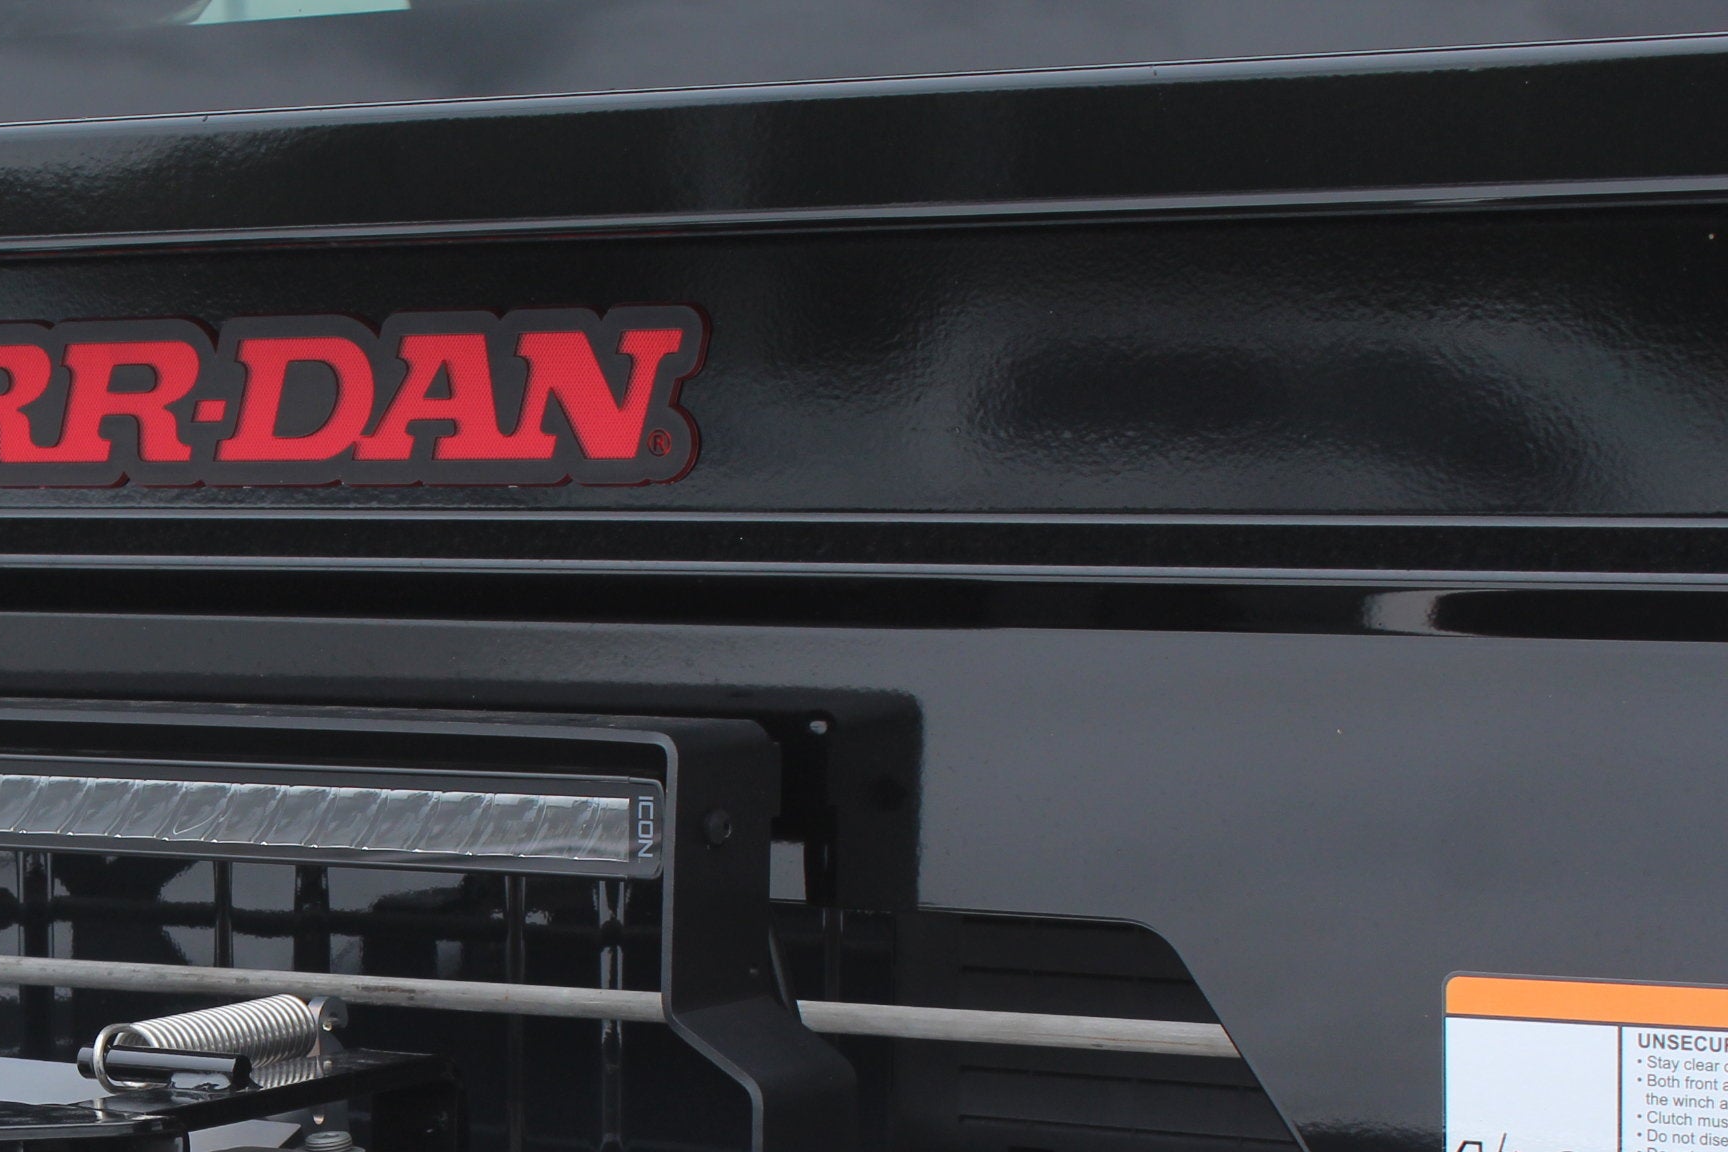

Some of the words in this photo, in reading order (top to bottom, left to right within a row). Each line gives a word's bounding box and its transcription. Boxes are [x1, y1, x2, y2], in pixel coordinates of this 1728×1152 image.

[638, 796, 654, 858] ICON
[1647, 1055, 1680, 1073] Stay
[1684, 1058, 1720, 1072] clear
[1647, 1074, 1680, 1089] Both
[1685, 1076, 1718, 1091] front
[1646, 1093, 1668, 1106] the
[1673, 1095, 1714, 1109] winch
[1647, 1111, 1692, 1126] Clutch
[1647, 1129, 1667, 1143] Do
[1672, 1132, 1695, 1145] not
